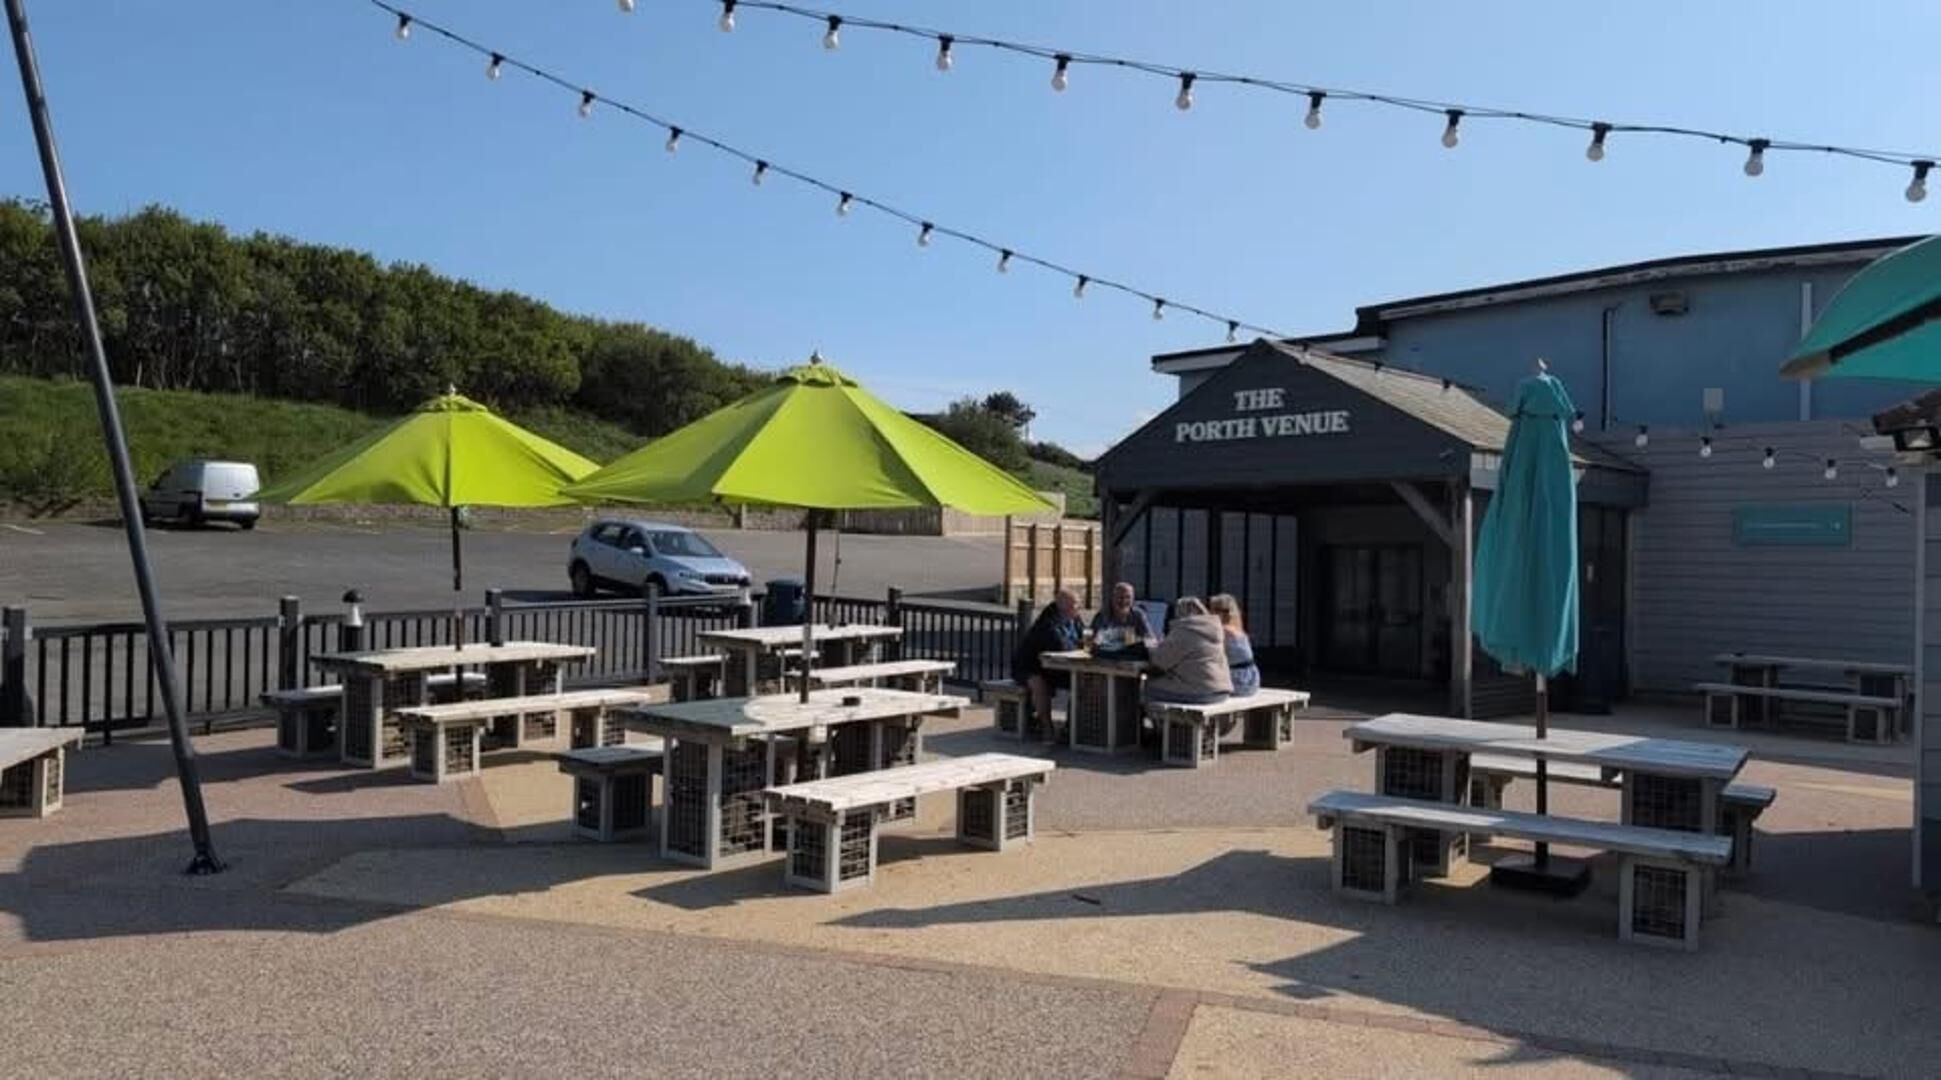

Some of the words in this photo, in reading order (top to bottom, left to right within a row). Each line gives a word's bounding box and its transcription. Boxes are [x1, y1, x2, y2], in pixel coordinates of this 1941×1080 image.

[1234, 388, 1285, 411] THE
[1175, 418, 1256, 442] PORTH
[1261, 411, 1349, 436] VENUE
